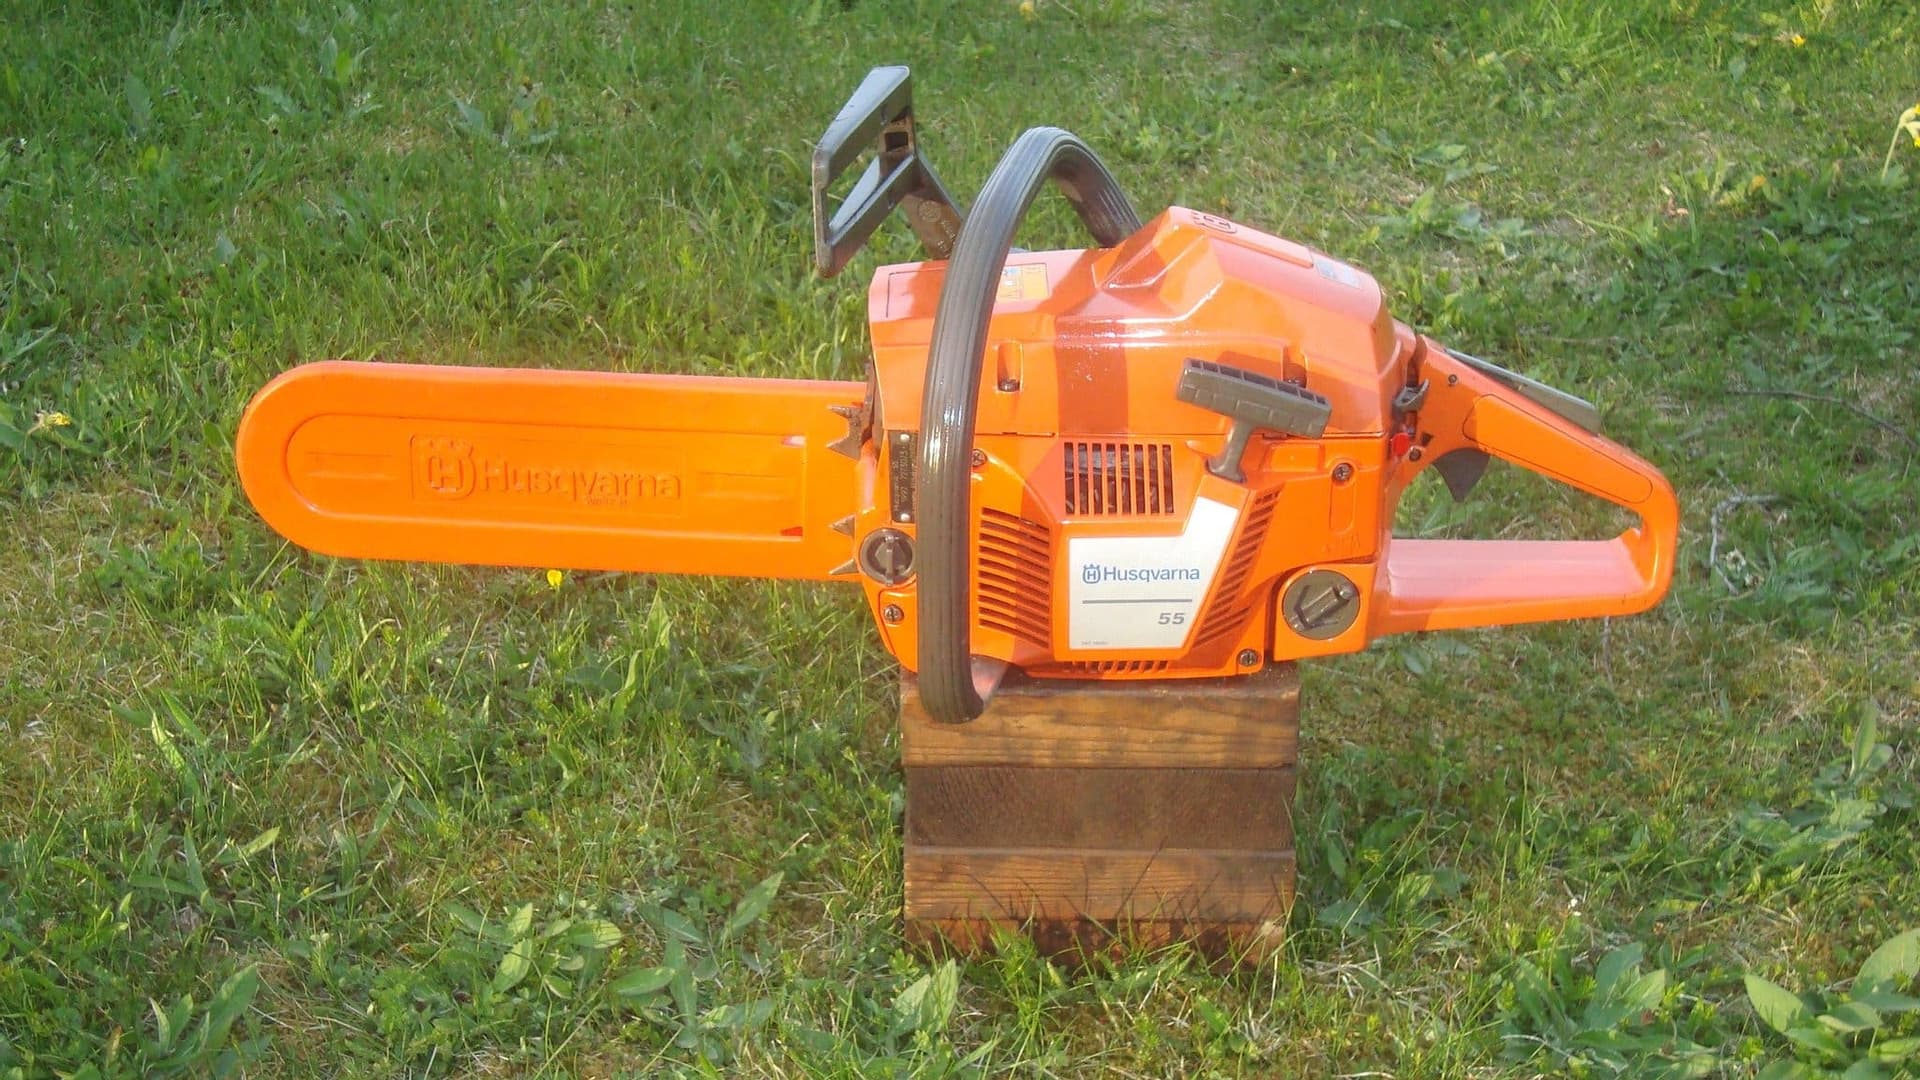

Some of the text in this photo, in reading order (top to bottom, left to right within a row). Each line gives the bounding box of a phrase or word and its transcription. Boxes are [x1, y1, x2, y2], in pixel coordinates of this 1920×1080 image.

[485, 457, 682, 502] Husqvarna
[1103, 565, 1200, 583] Husqvarna
[1158, 612, 1185, 625] 55
